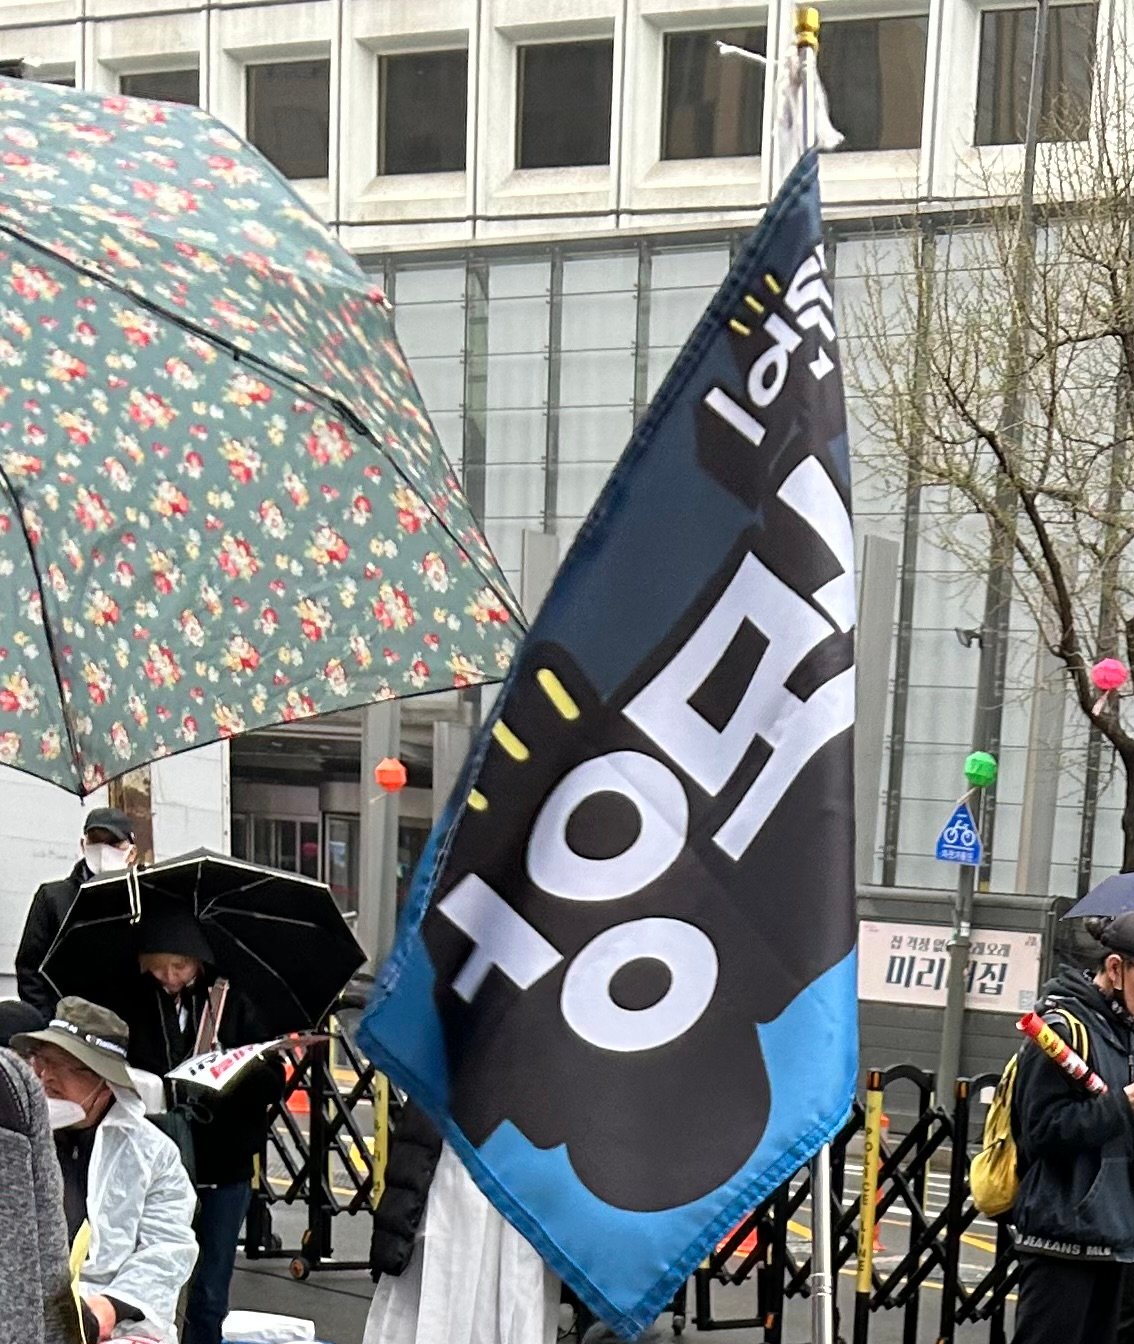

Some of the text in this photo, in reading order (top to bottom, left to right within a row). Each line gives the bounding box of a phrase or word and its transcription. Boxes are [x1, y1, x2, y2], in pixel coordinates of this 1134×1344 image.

[906, 937, 931, 952] 걱정
[969, 942, 1011, 957] 래오래
[886, 955, 1008, 995] 미리집
